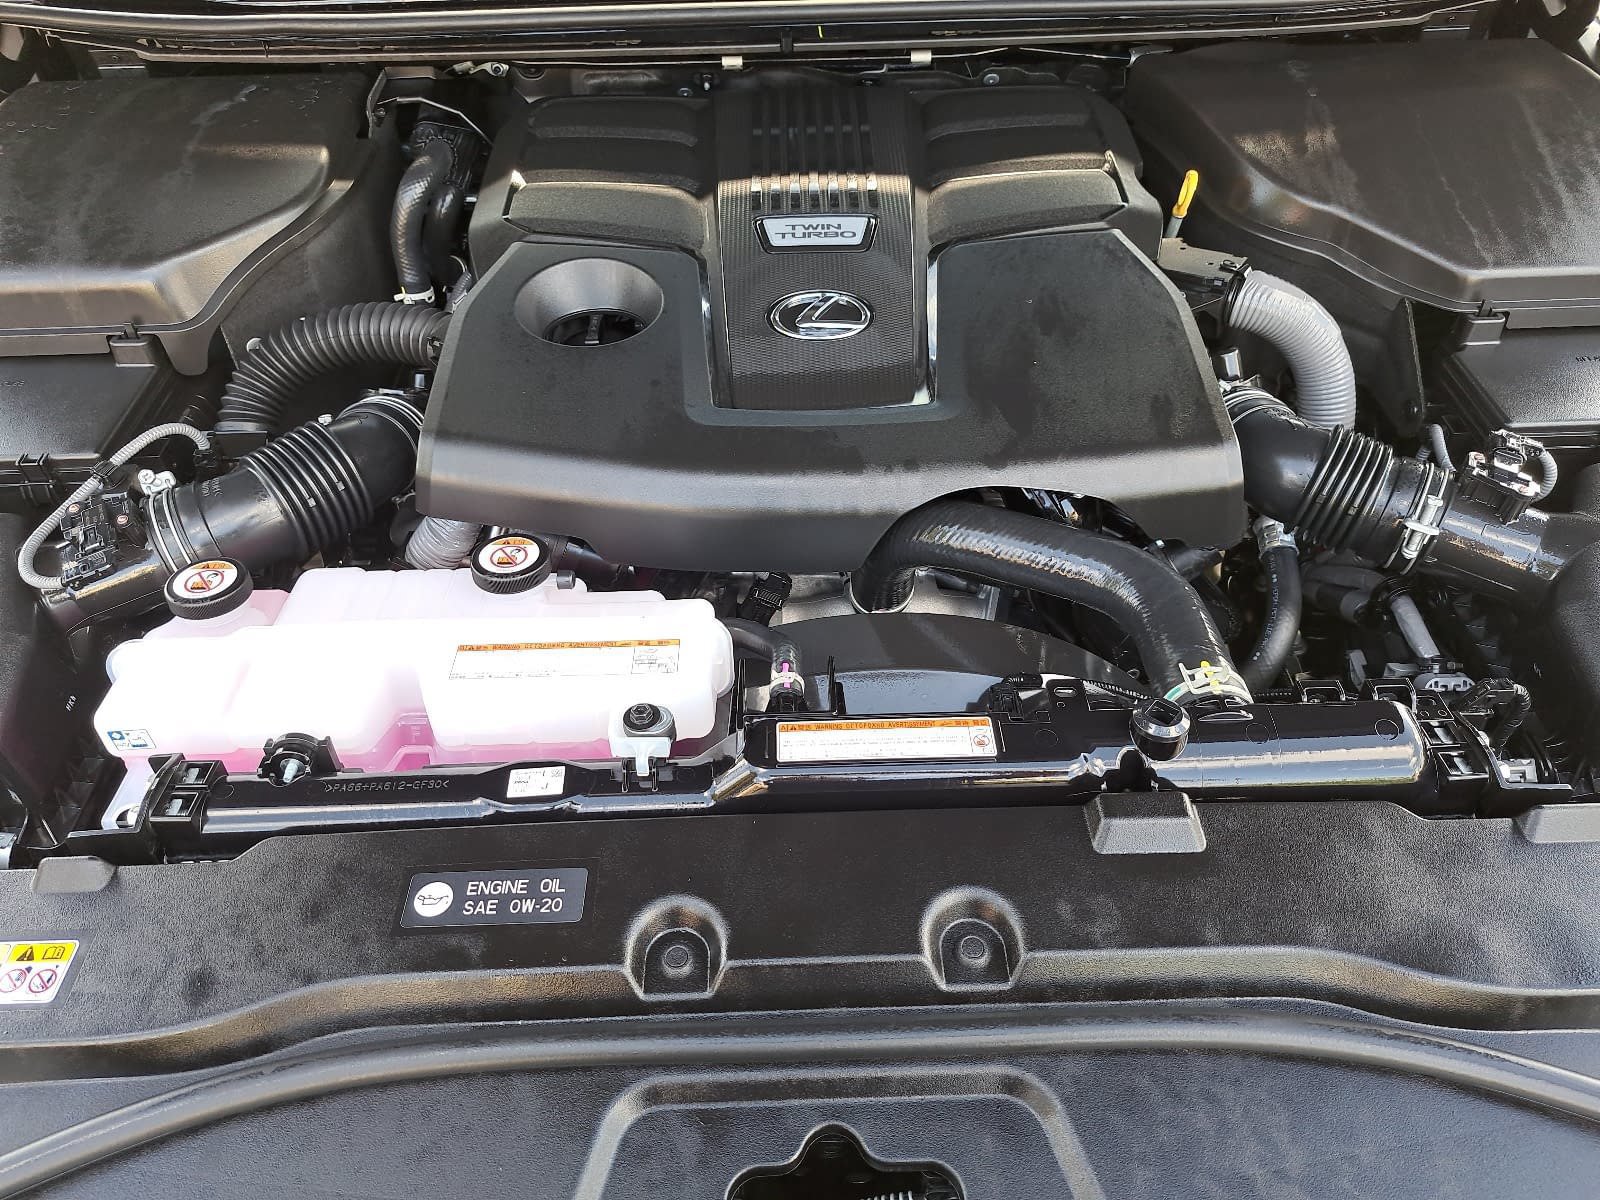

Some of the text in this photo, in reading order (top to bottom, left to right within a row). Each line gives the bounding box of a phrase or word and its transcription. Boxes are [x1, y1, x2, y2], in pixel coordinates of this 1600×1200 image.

[785, 223, 842, 231] TWIN
[775, 231, 857, 239] TURBO
[815, 723, 843, 731] WARNING
[887, 720, 935, 728] AVERTISSEMENT
[466, 879, 566, 895] ENGINE OIL
[463, 898, 563, 915] SAE 0W-20
